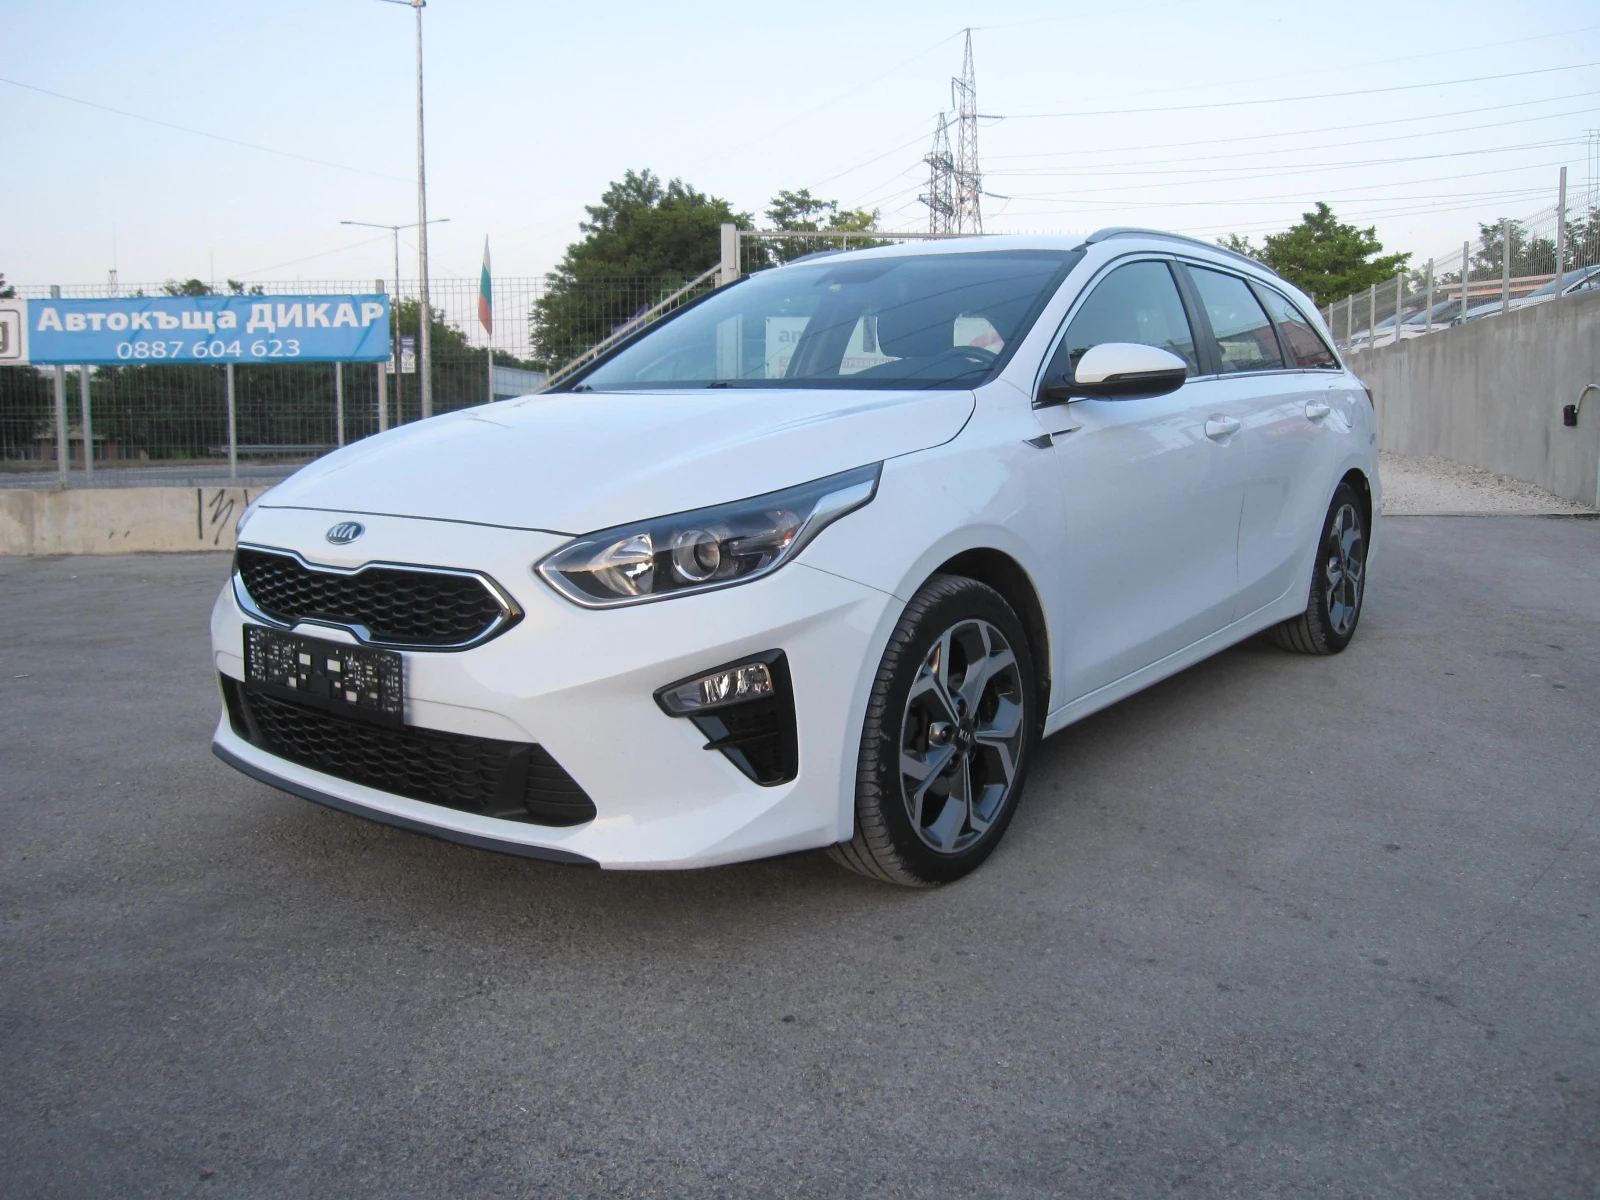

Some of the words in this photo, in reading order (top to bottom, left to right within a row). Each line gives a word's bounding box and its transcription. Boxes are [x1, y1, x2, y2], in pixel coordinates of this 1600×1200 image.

[37, 306, 238, 335] Автокъща
[246, 302, 385, 334] ДИКАР
[116, 341, 184, 360] 0887
[192, 340, 243, 359] 604
[250, 339, 301, 358] 623
[328, 523, 358, 540] KIA
